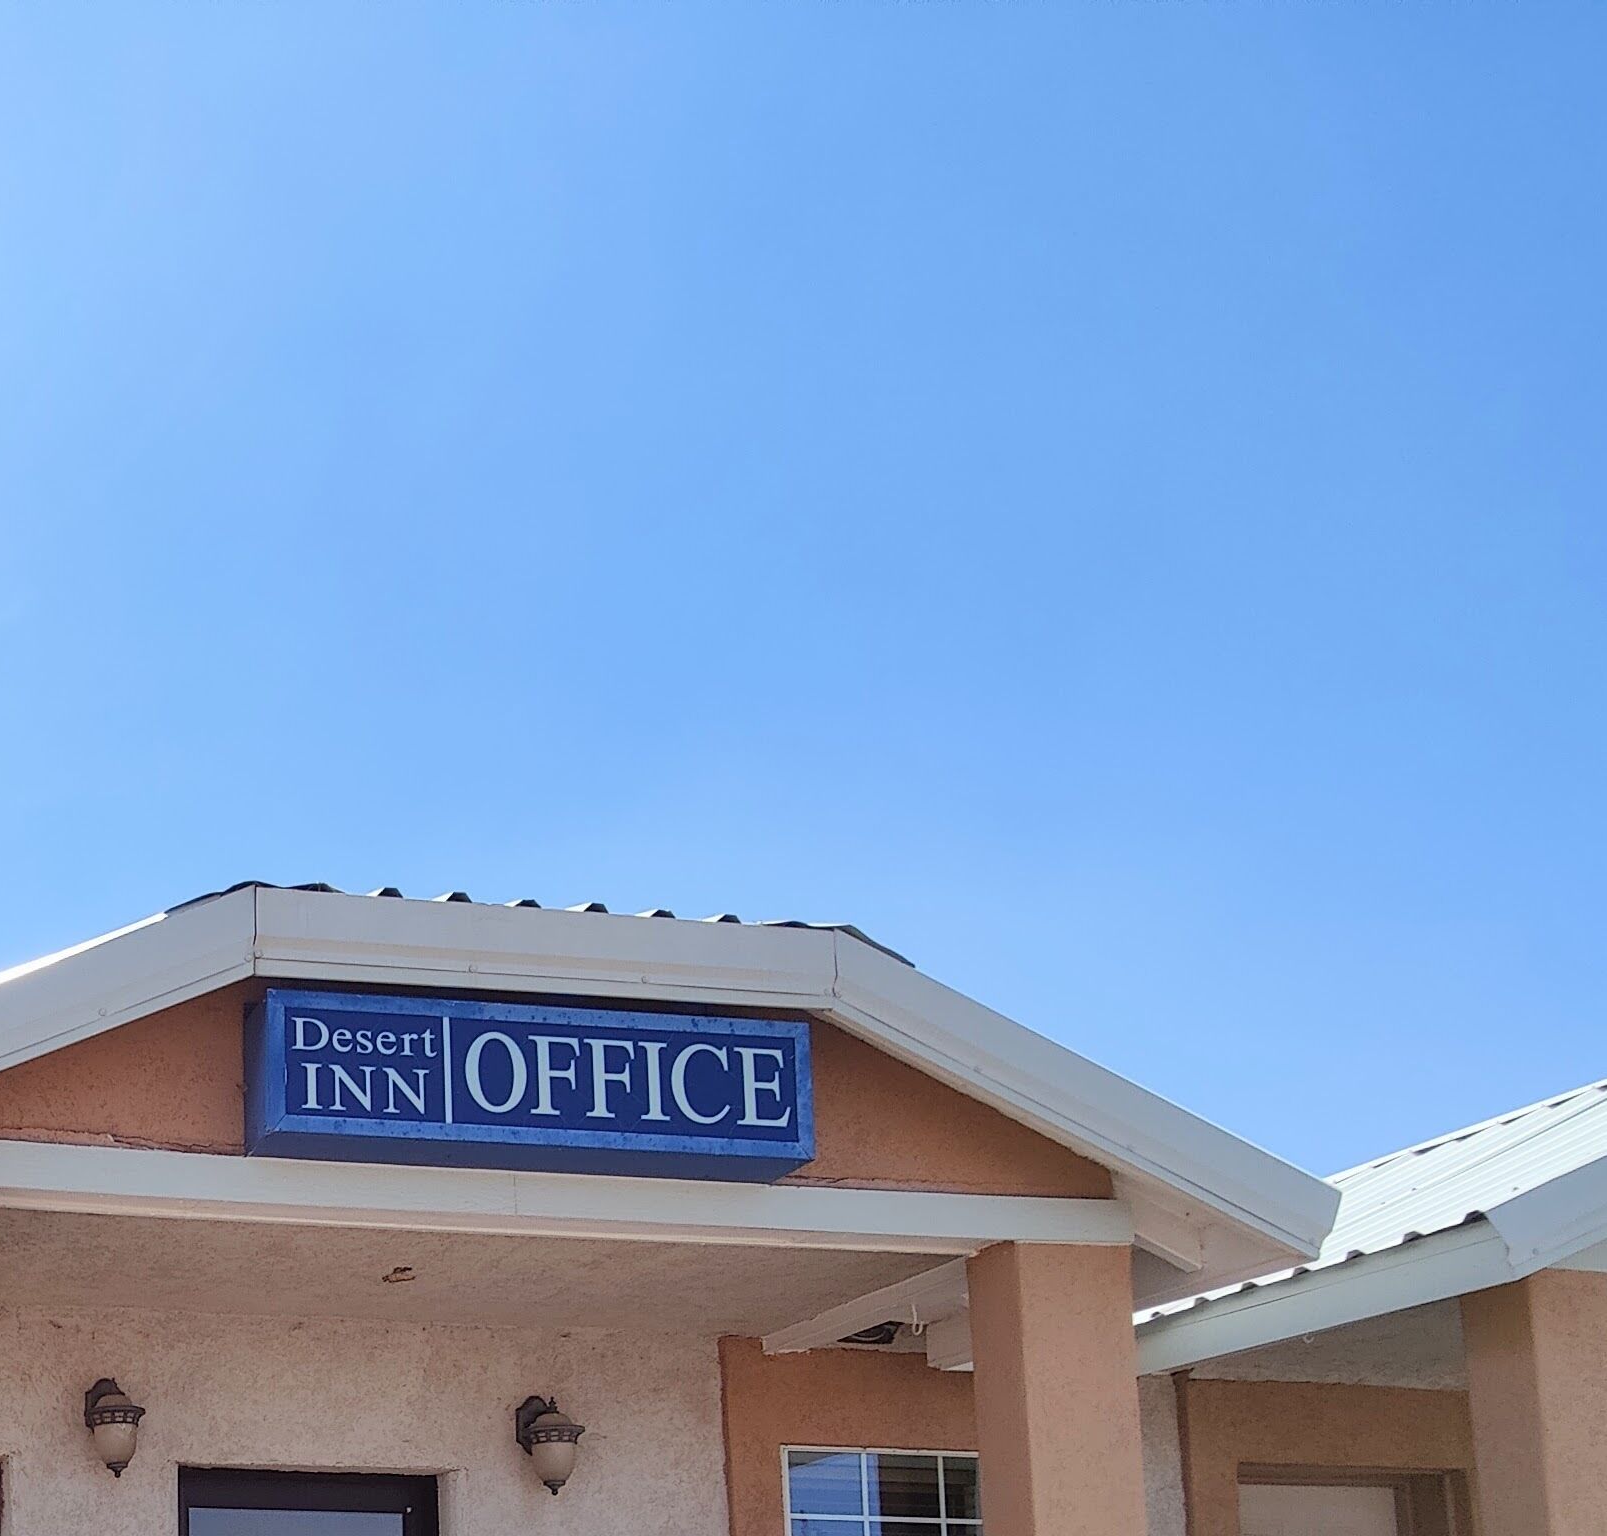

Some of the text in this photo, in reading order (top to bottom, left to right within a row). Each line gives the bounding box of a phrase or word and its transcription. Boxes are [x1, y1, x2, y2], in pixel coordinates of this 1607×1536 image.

[291, 1016, 438, 1060] Desert
[301, 1062, 430, 1115] INN
[464, 1031, 791, 1129] OFFICE
